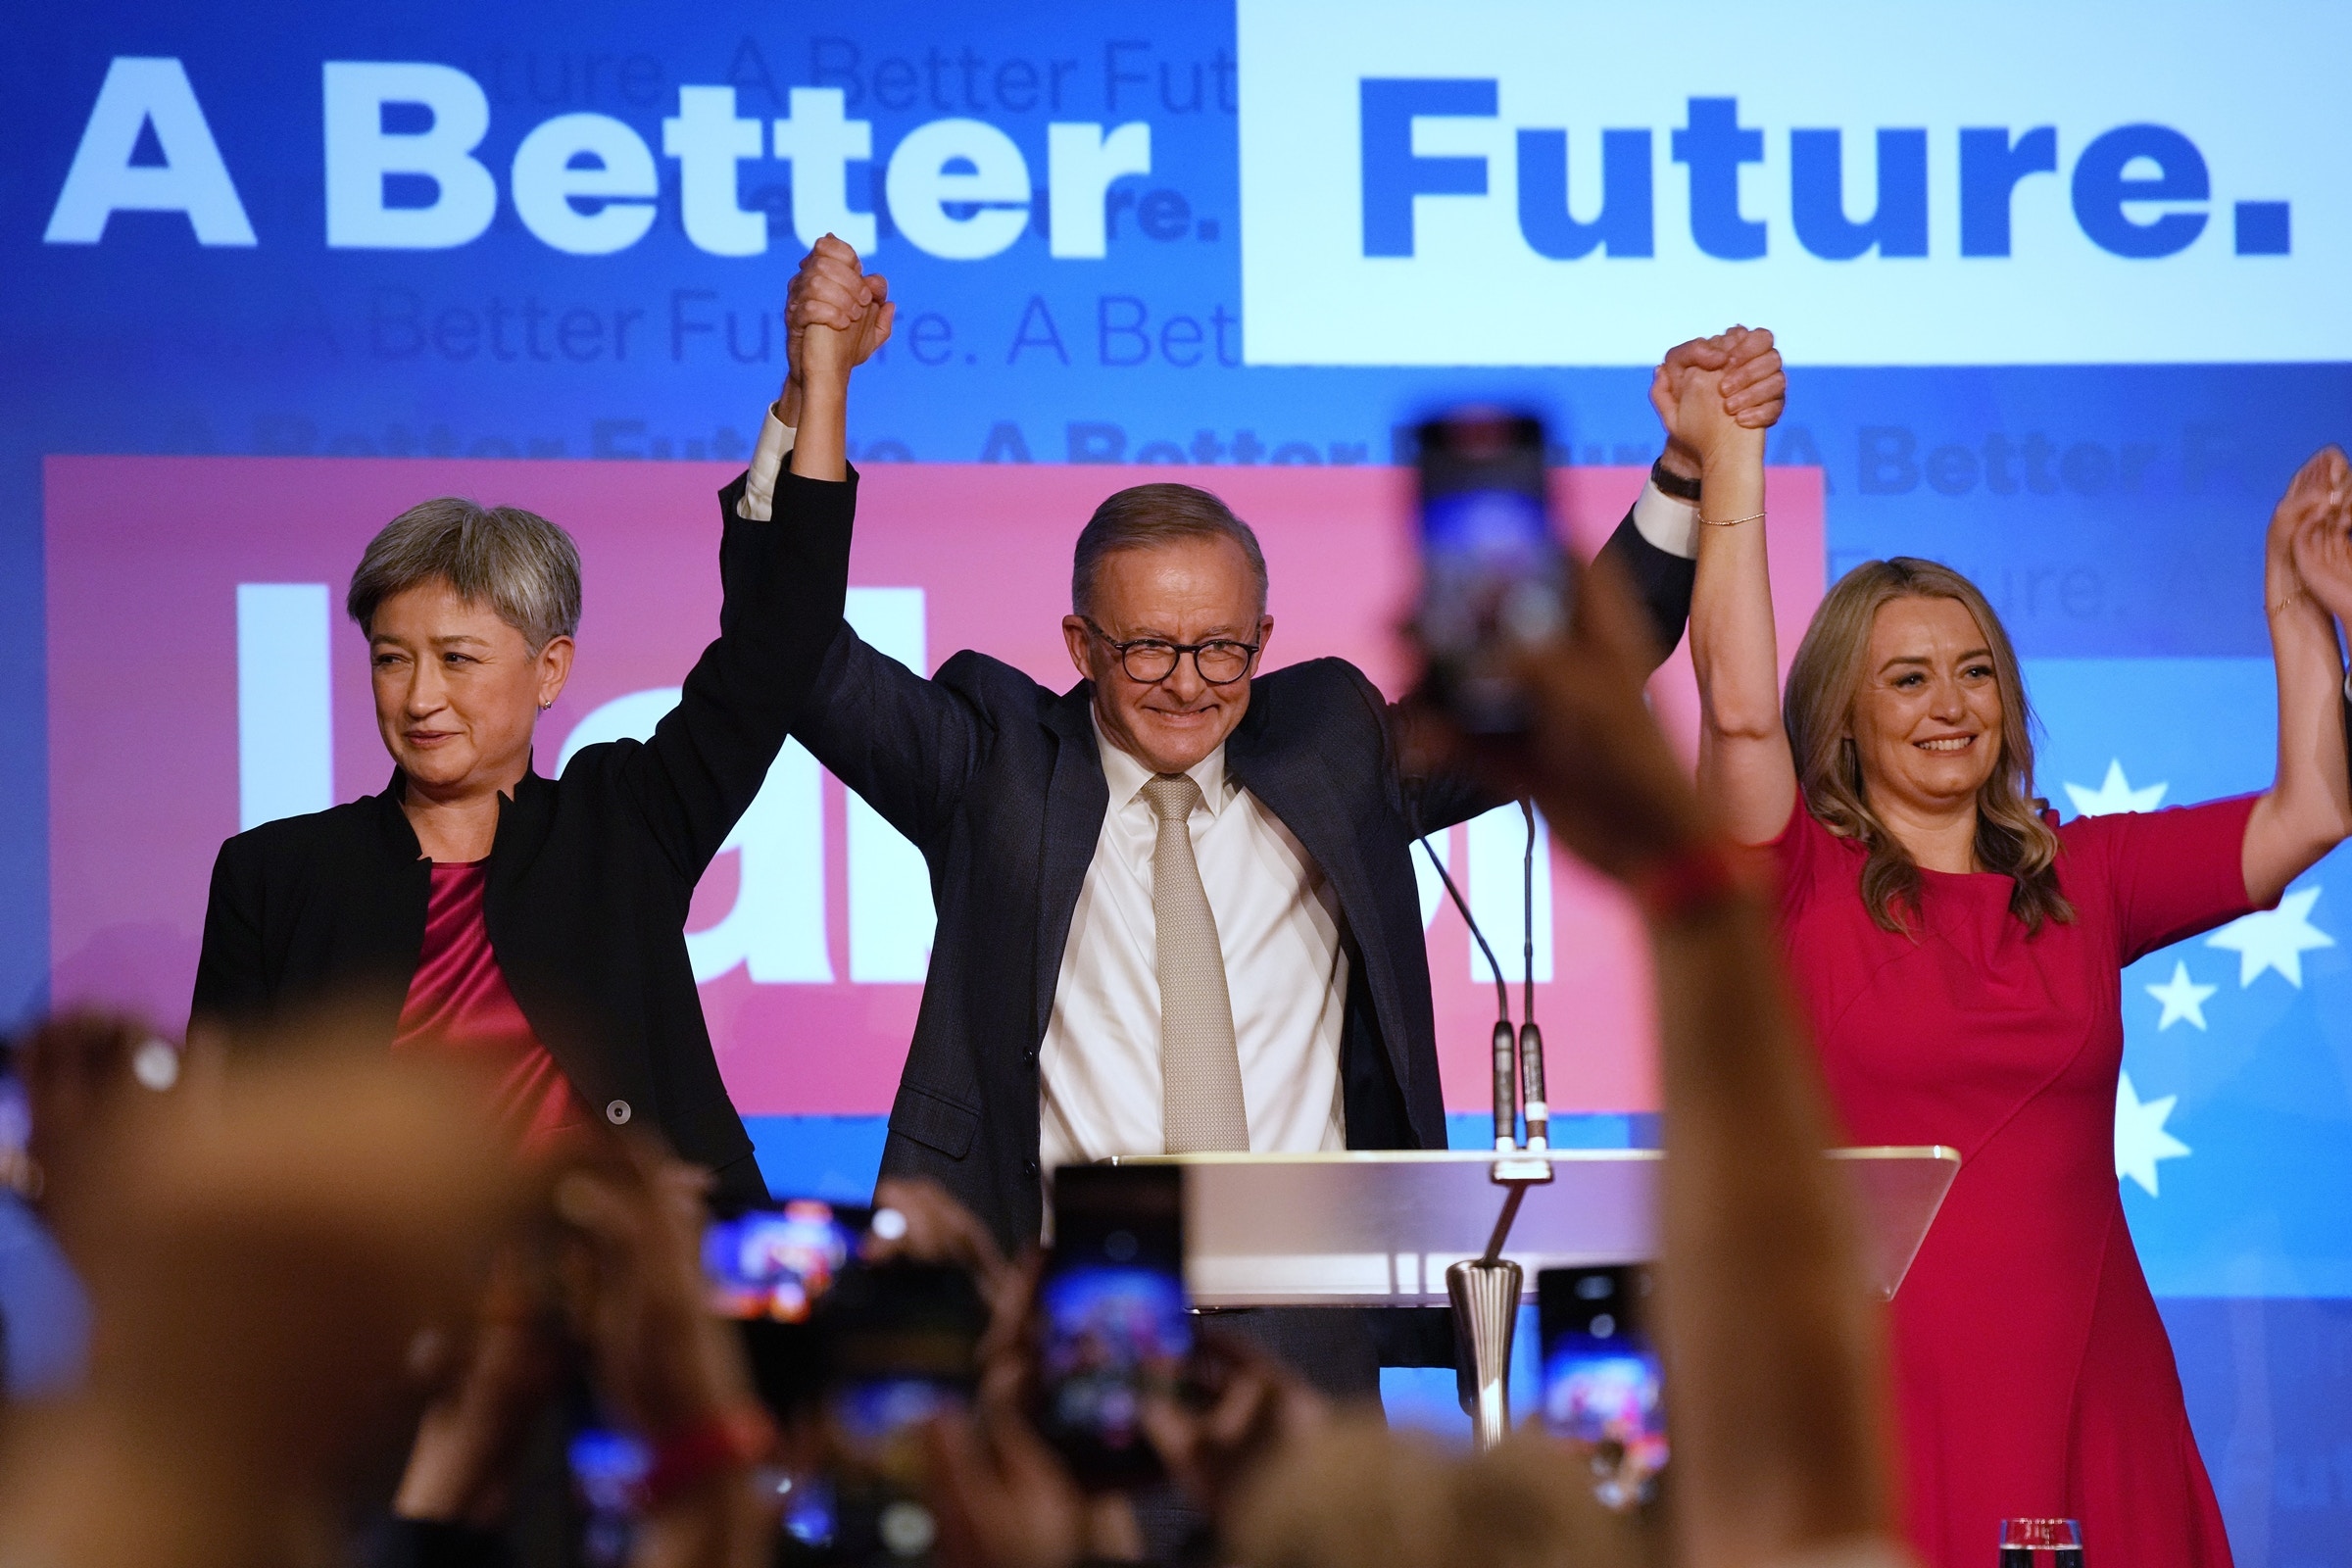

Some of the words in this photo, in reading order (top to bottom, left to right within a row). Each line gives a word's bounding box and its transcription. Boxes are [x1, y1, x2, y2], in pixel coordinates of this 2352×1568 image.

[43, 55, 256, 246] A
[320, 59, 1152, 258] Better
[1358, 75, 2294, 259] Future.
[368, 284, 646, 364] Better
[1004, 292, 1072, 368] A
[1857, 424, 2161, 497] Better
